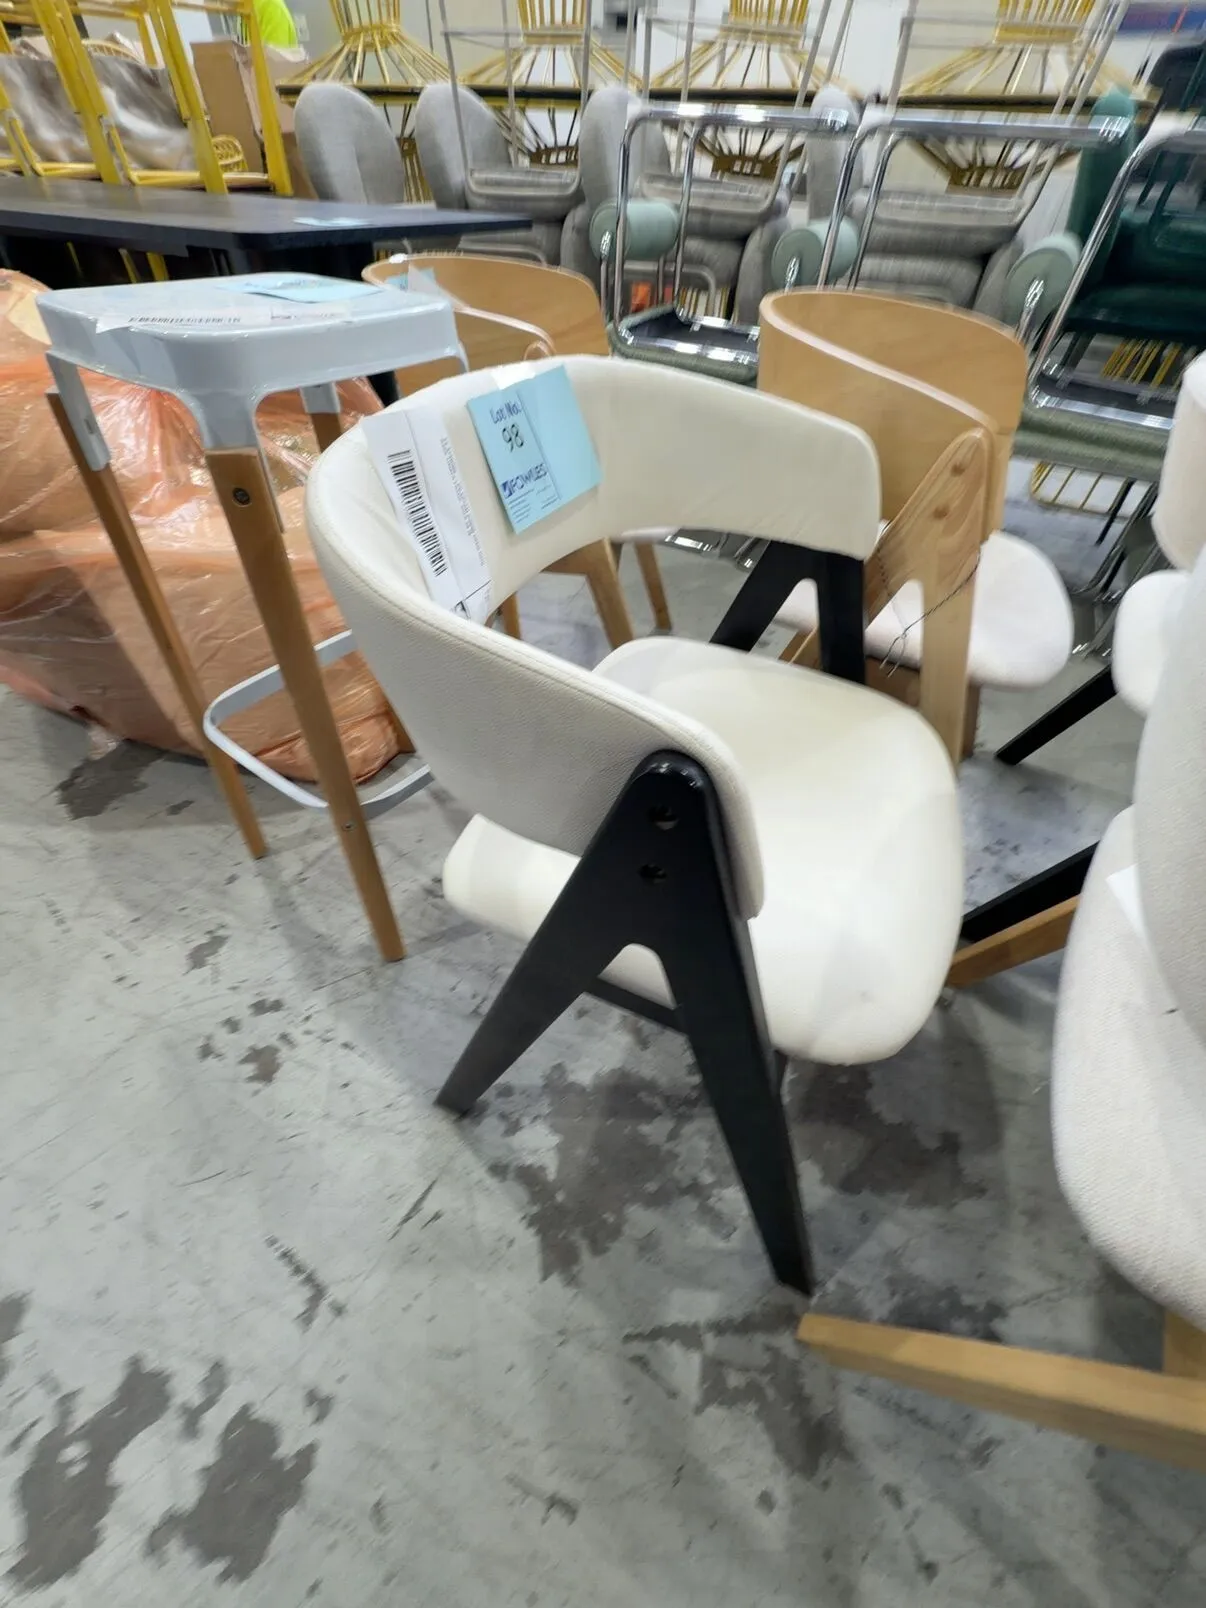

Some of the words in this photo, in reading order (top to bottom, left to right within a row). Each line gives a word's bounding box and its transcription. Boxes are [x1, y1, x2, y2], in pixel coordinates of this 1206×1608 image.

[490, 408, 506, 424] Lot
[501, 424, 524, 453] 98
[509, 463, 548, 493] FOWLES
